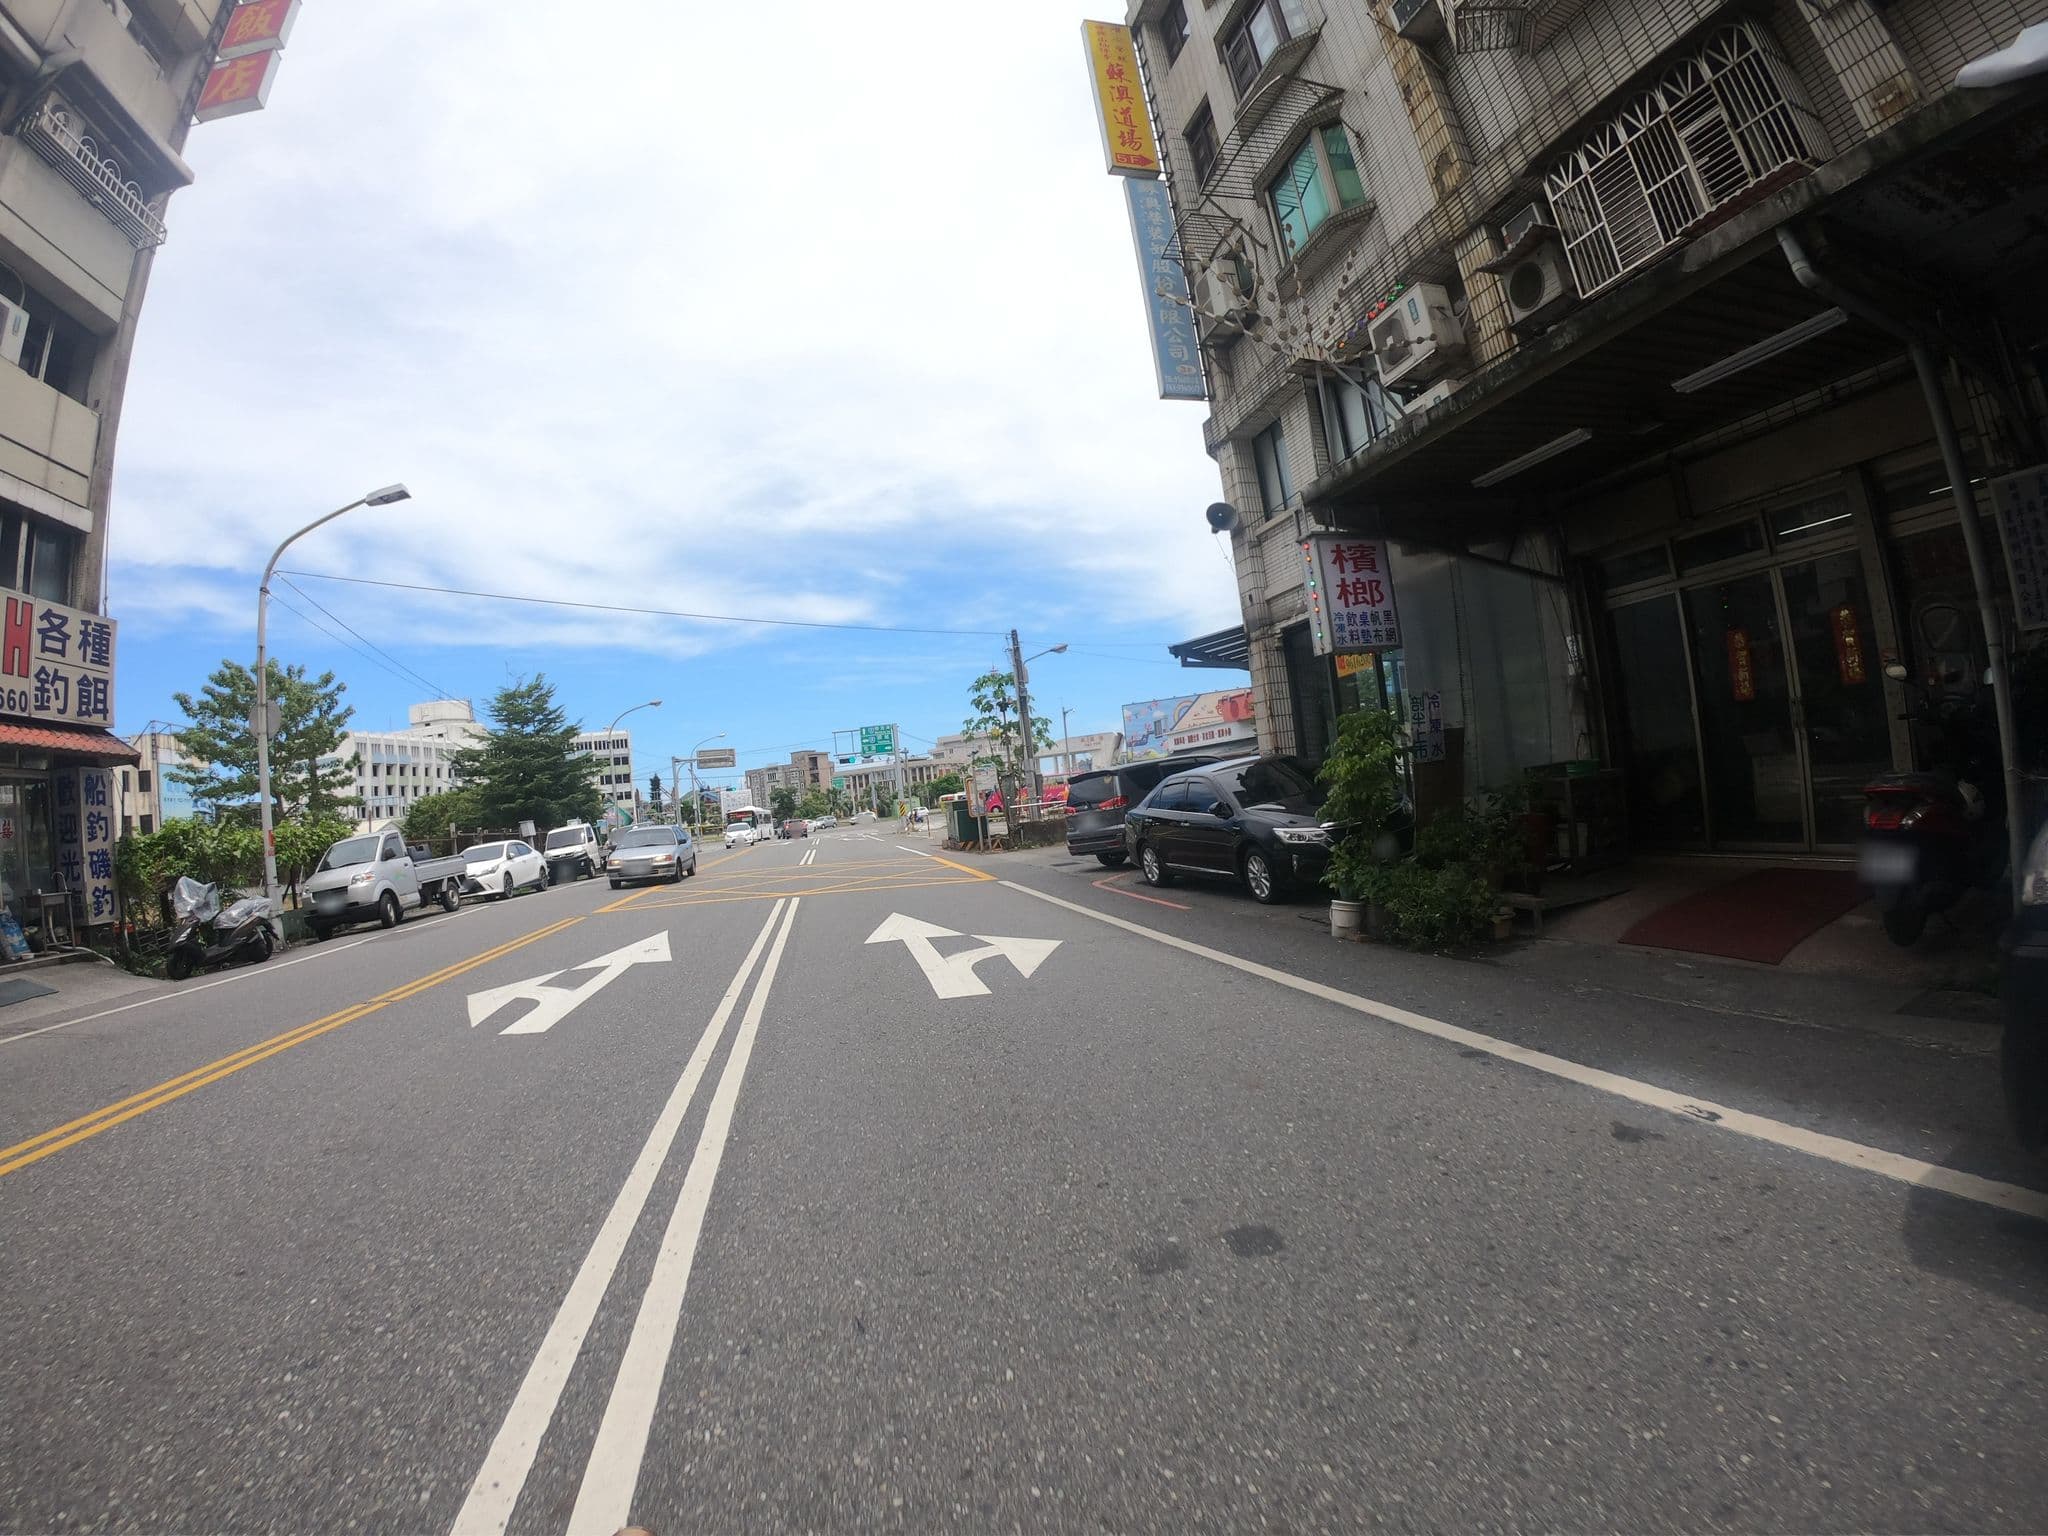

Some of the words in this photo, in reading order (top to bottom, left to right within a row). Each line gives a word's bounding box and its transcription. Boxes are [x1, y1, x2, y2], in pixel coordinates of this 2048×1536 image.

[1331, 544, 1385, 608] 檳榔
[37, 608, 111, 667] 各種
[1346, 611, 1360, 644] 飲料
[34, 665, 111, 721] 釣餌
[84, 774, 114, 918] 船釣磯釣
